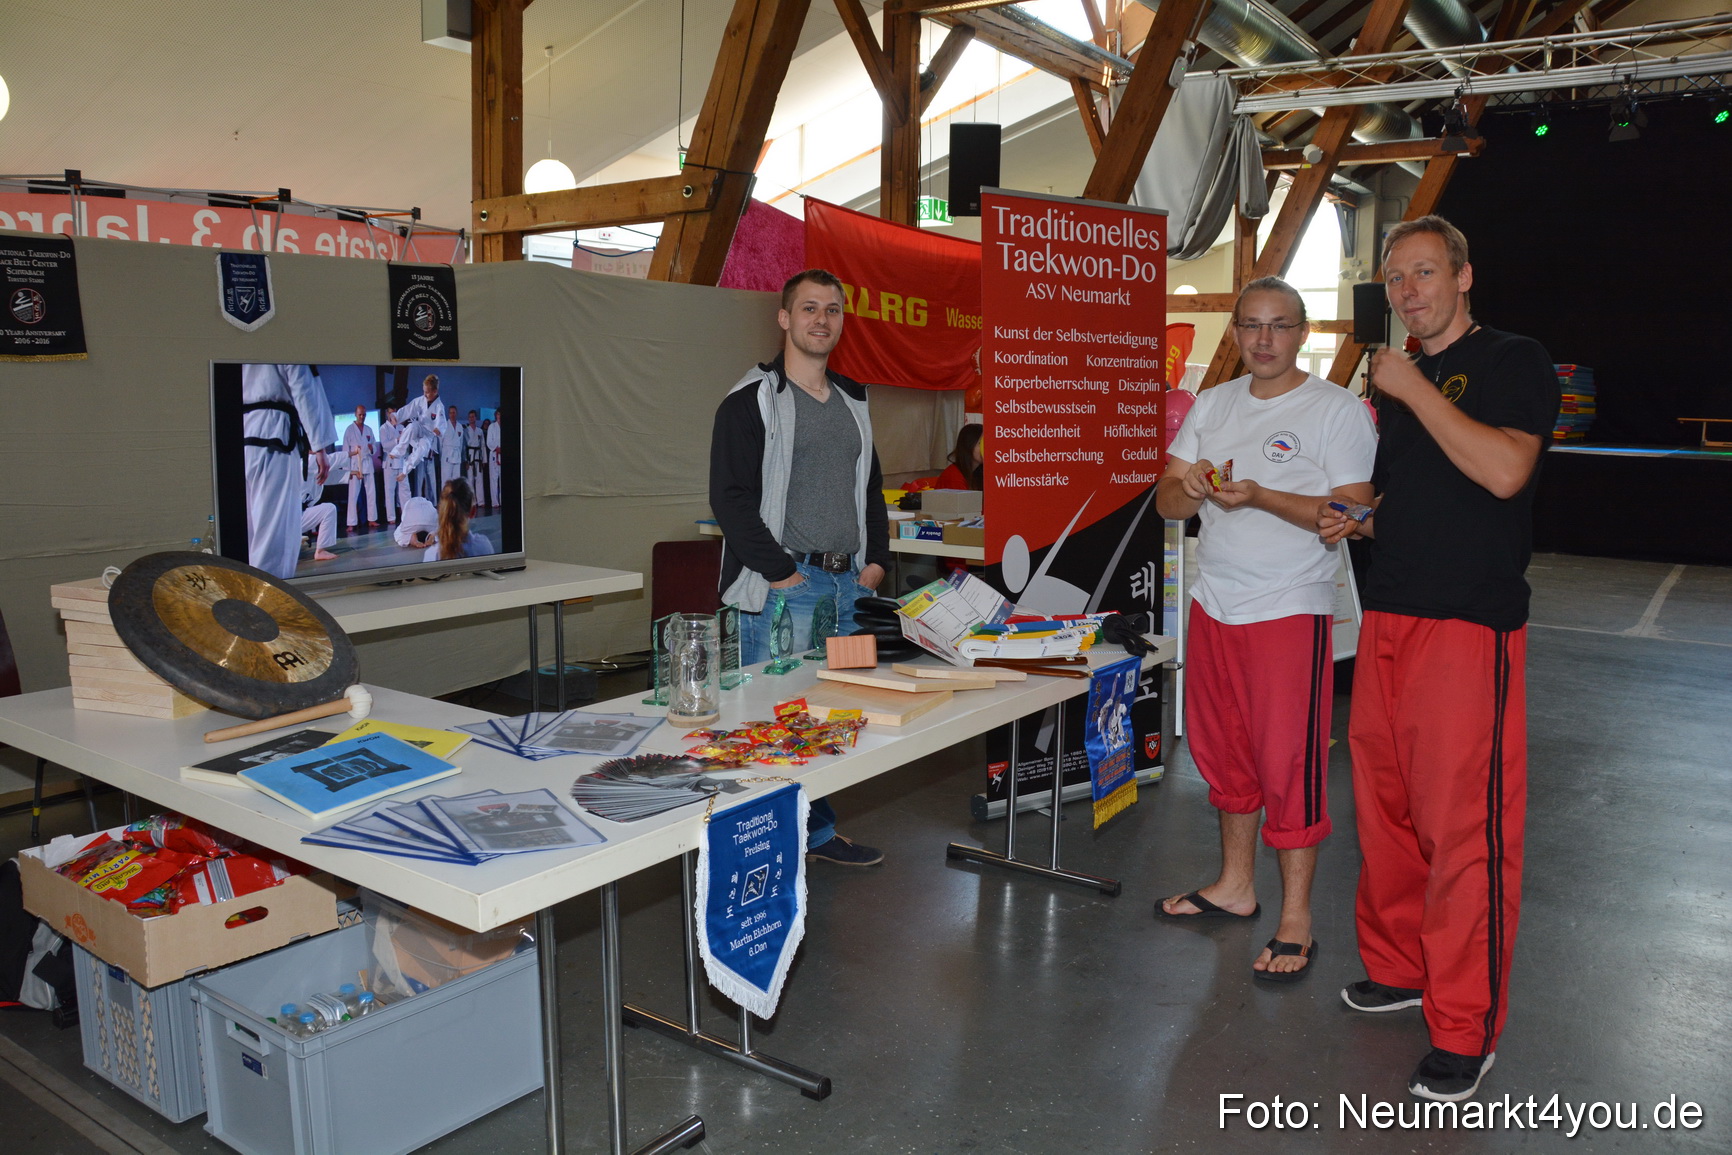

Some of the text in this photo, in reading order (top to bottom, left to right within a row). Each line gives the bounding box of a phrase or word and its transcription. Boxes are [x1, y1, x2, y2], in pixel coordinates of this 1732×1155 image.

[991, 205, 1160, 251] Traditionelles
[996, 241, 1157, 283] Taekwon-Do
[1025, 282, 1131, 306] ASV Neumarkt
[994, 325, 1159, 350] Kunst der Selbstverteidigung
[994, 350, 1068, 366] Koordination
[1086, 354, 1159, 369] Konzentration
[994, 375, 1160, 395] Körperbeherrschung Disziplin
[995, 400, 1158, 418] Selbstbewusstsein Respekt
[995, 423, 1158, 439] Bescheidenheit Höflichkeit
[994, 446, 1158, 465] Selbstbeherrschung Geduld
[995, 471, 1157, 488] Willensstärke Ausdauer
[357, 735, 380, 744] KWON
[736, 809, 774, 833] Traditional
[732, 820, 778, 846] Taekwon-Do
[744, 839, 770, 858] Freising
[83, 855, 130, 884] PARTY MIX
[740, 910, 767, 930] seit 1996
[729, 919, 782, 951] Martin Eichhorn
